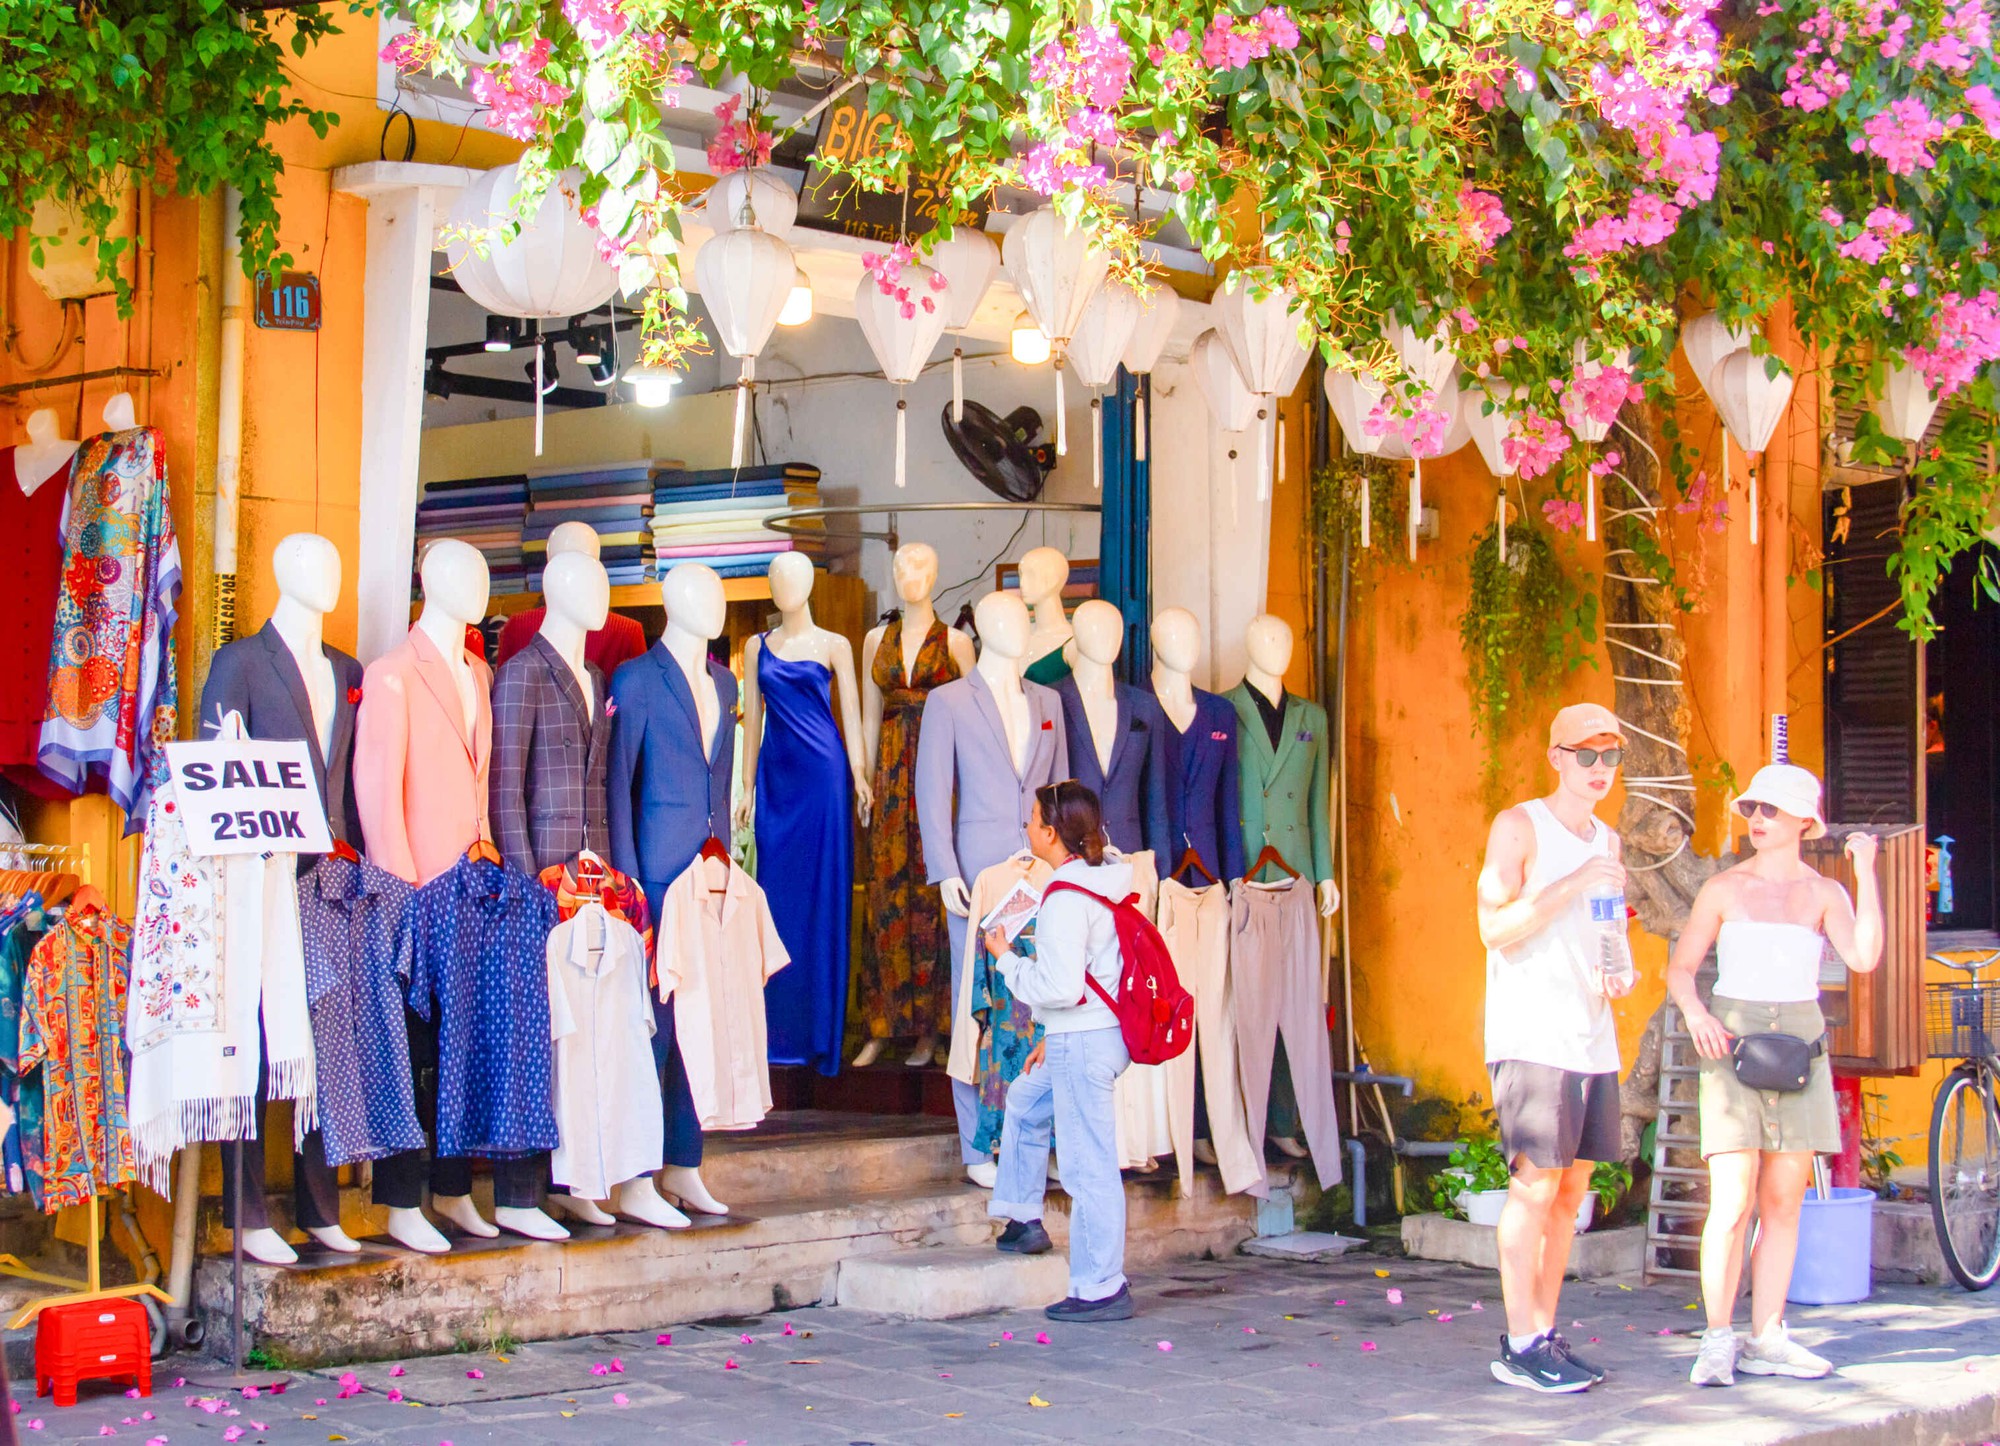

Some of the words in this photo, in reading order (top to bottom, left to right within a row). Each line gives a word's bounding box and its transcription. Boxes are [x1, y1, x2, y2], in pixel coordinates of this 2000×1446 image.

[845, 219, 868, 241] 116
[272, 285, 309, 318] 116
[182, 760, 307, 791] SALE
[210, 810, 307, 840] 250K
